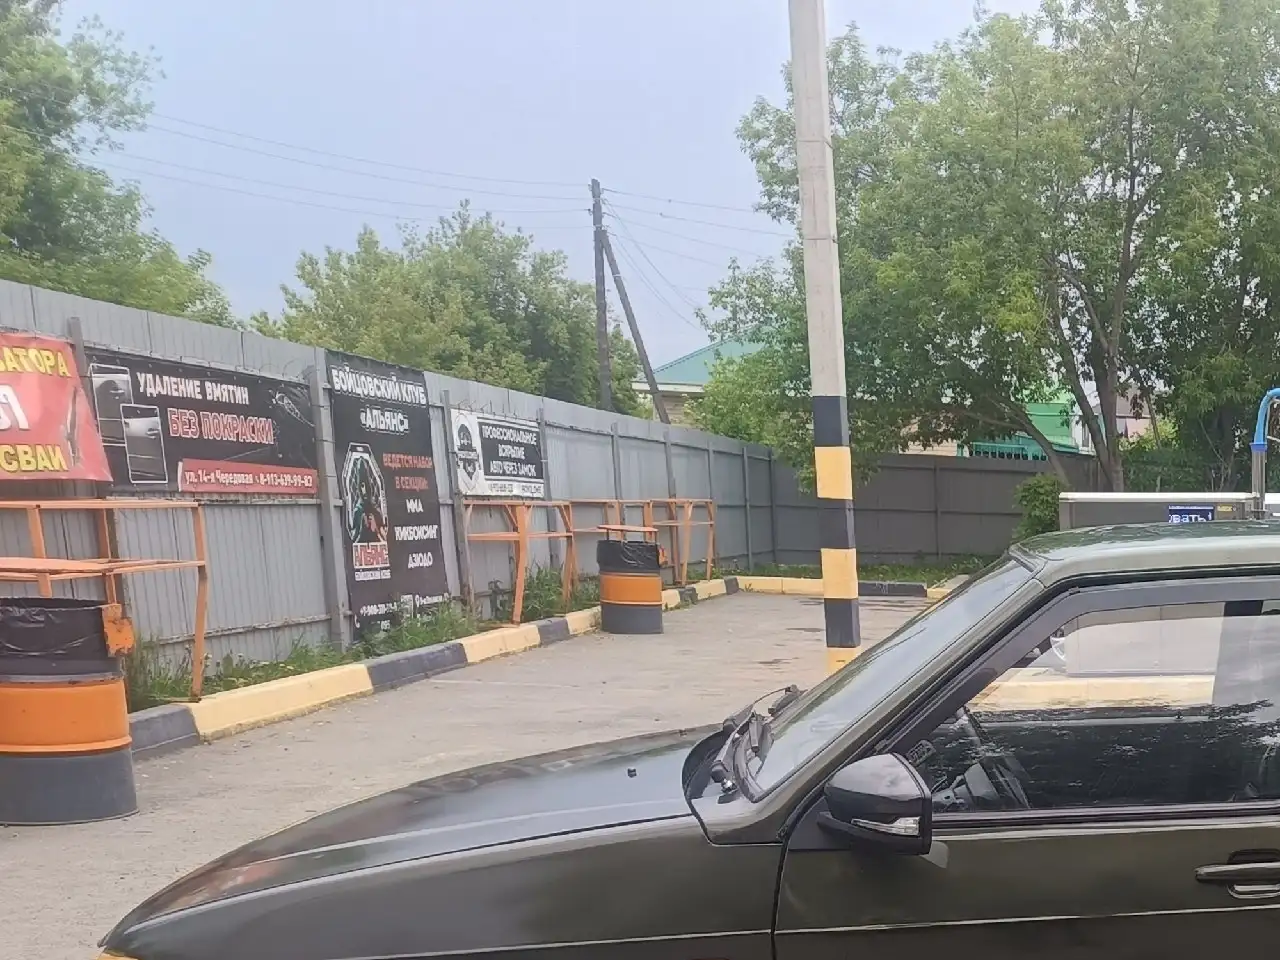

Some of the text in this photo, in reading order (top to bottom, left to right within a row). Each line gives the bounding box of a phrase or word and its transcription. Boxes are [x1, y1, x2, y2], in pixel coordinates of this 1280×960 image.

[136, 372, 250, 405] УДАЛЕНИЕ ВМЯТИН
[331, 364, 428, 406] БОЙЦОВСКИЙ КЛУБ
[167, 407, 275, 445] БЕЗ ПОКРАСКИ
[360, 406, 409, 432] «АЛЬЯНС»
[185, 471, 198, 486] ул.
[406, 499, 424, 513] ММА
[394, 525, 438, 541] КИКБОКСИНГ
[408, 552, 433, 568] ДЗЮДО
